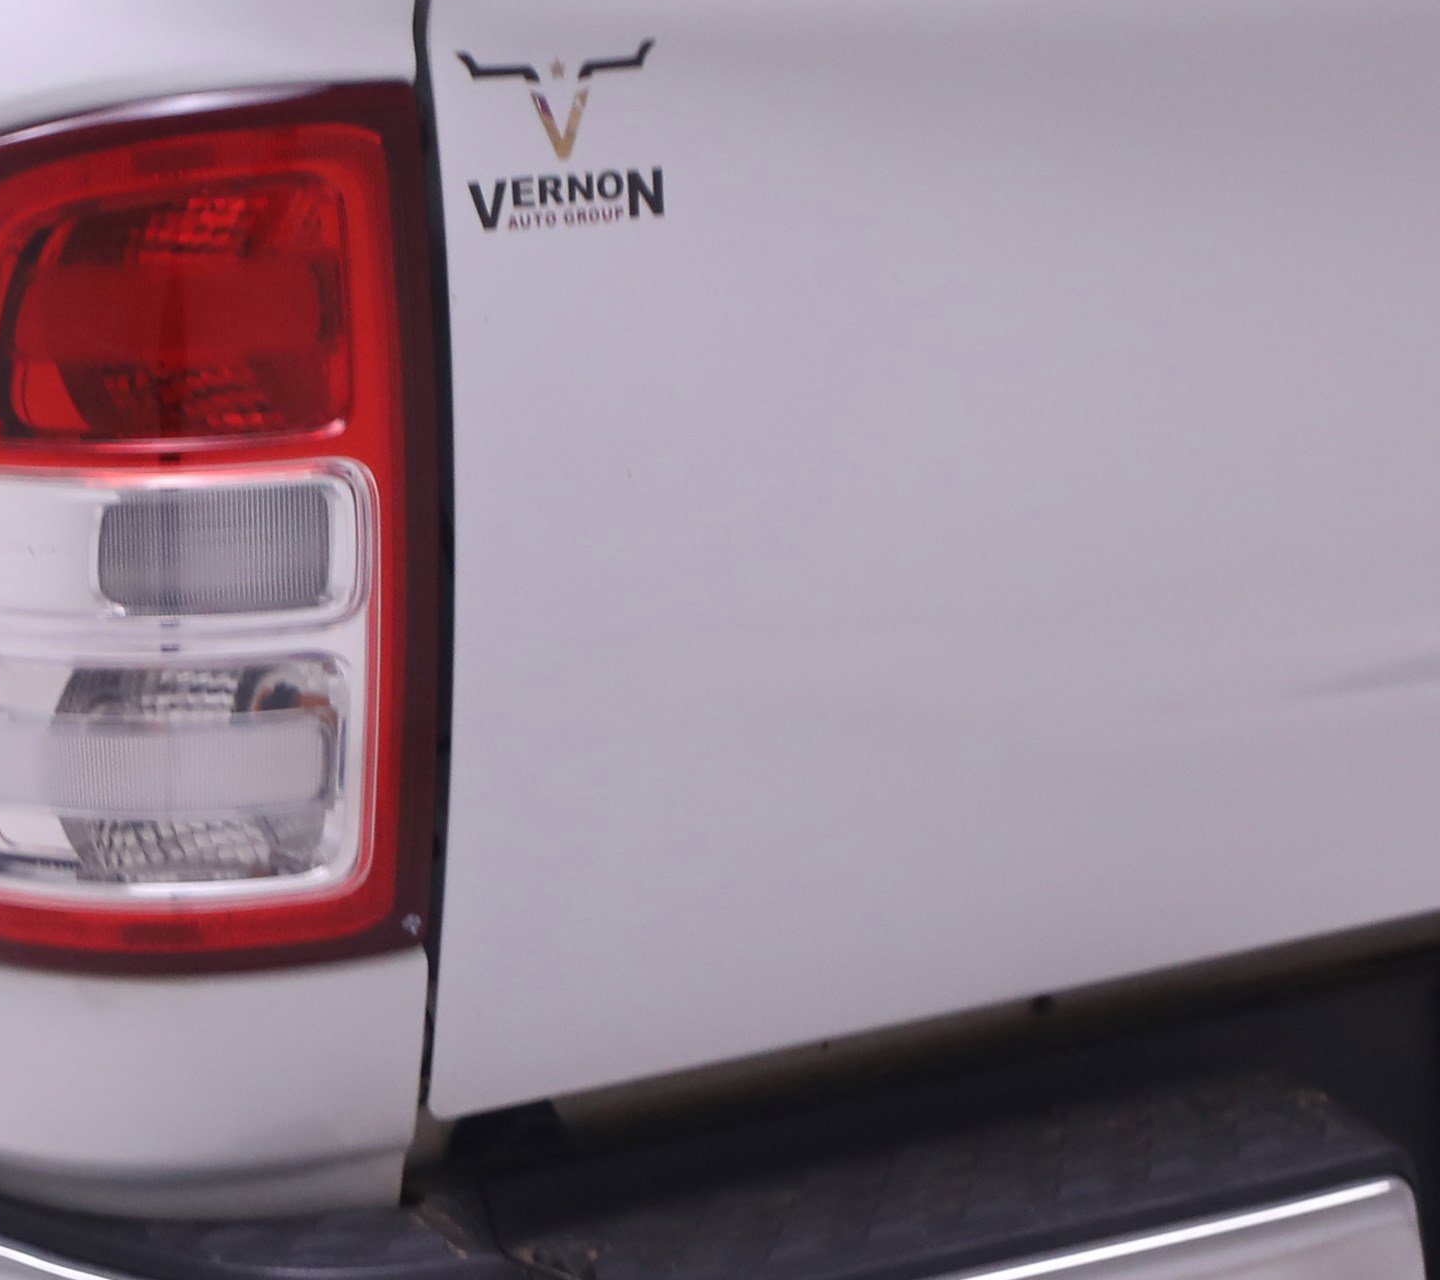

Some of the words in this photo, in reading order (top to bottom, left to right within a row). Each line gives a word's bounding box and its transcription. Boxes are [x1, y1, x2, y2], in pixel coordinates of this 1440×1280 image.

[467, 165, 666, 232] VERNON
[507, 213, 557, 231] AUTO
[563, 205, 625, 227] GROUP
